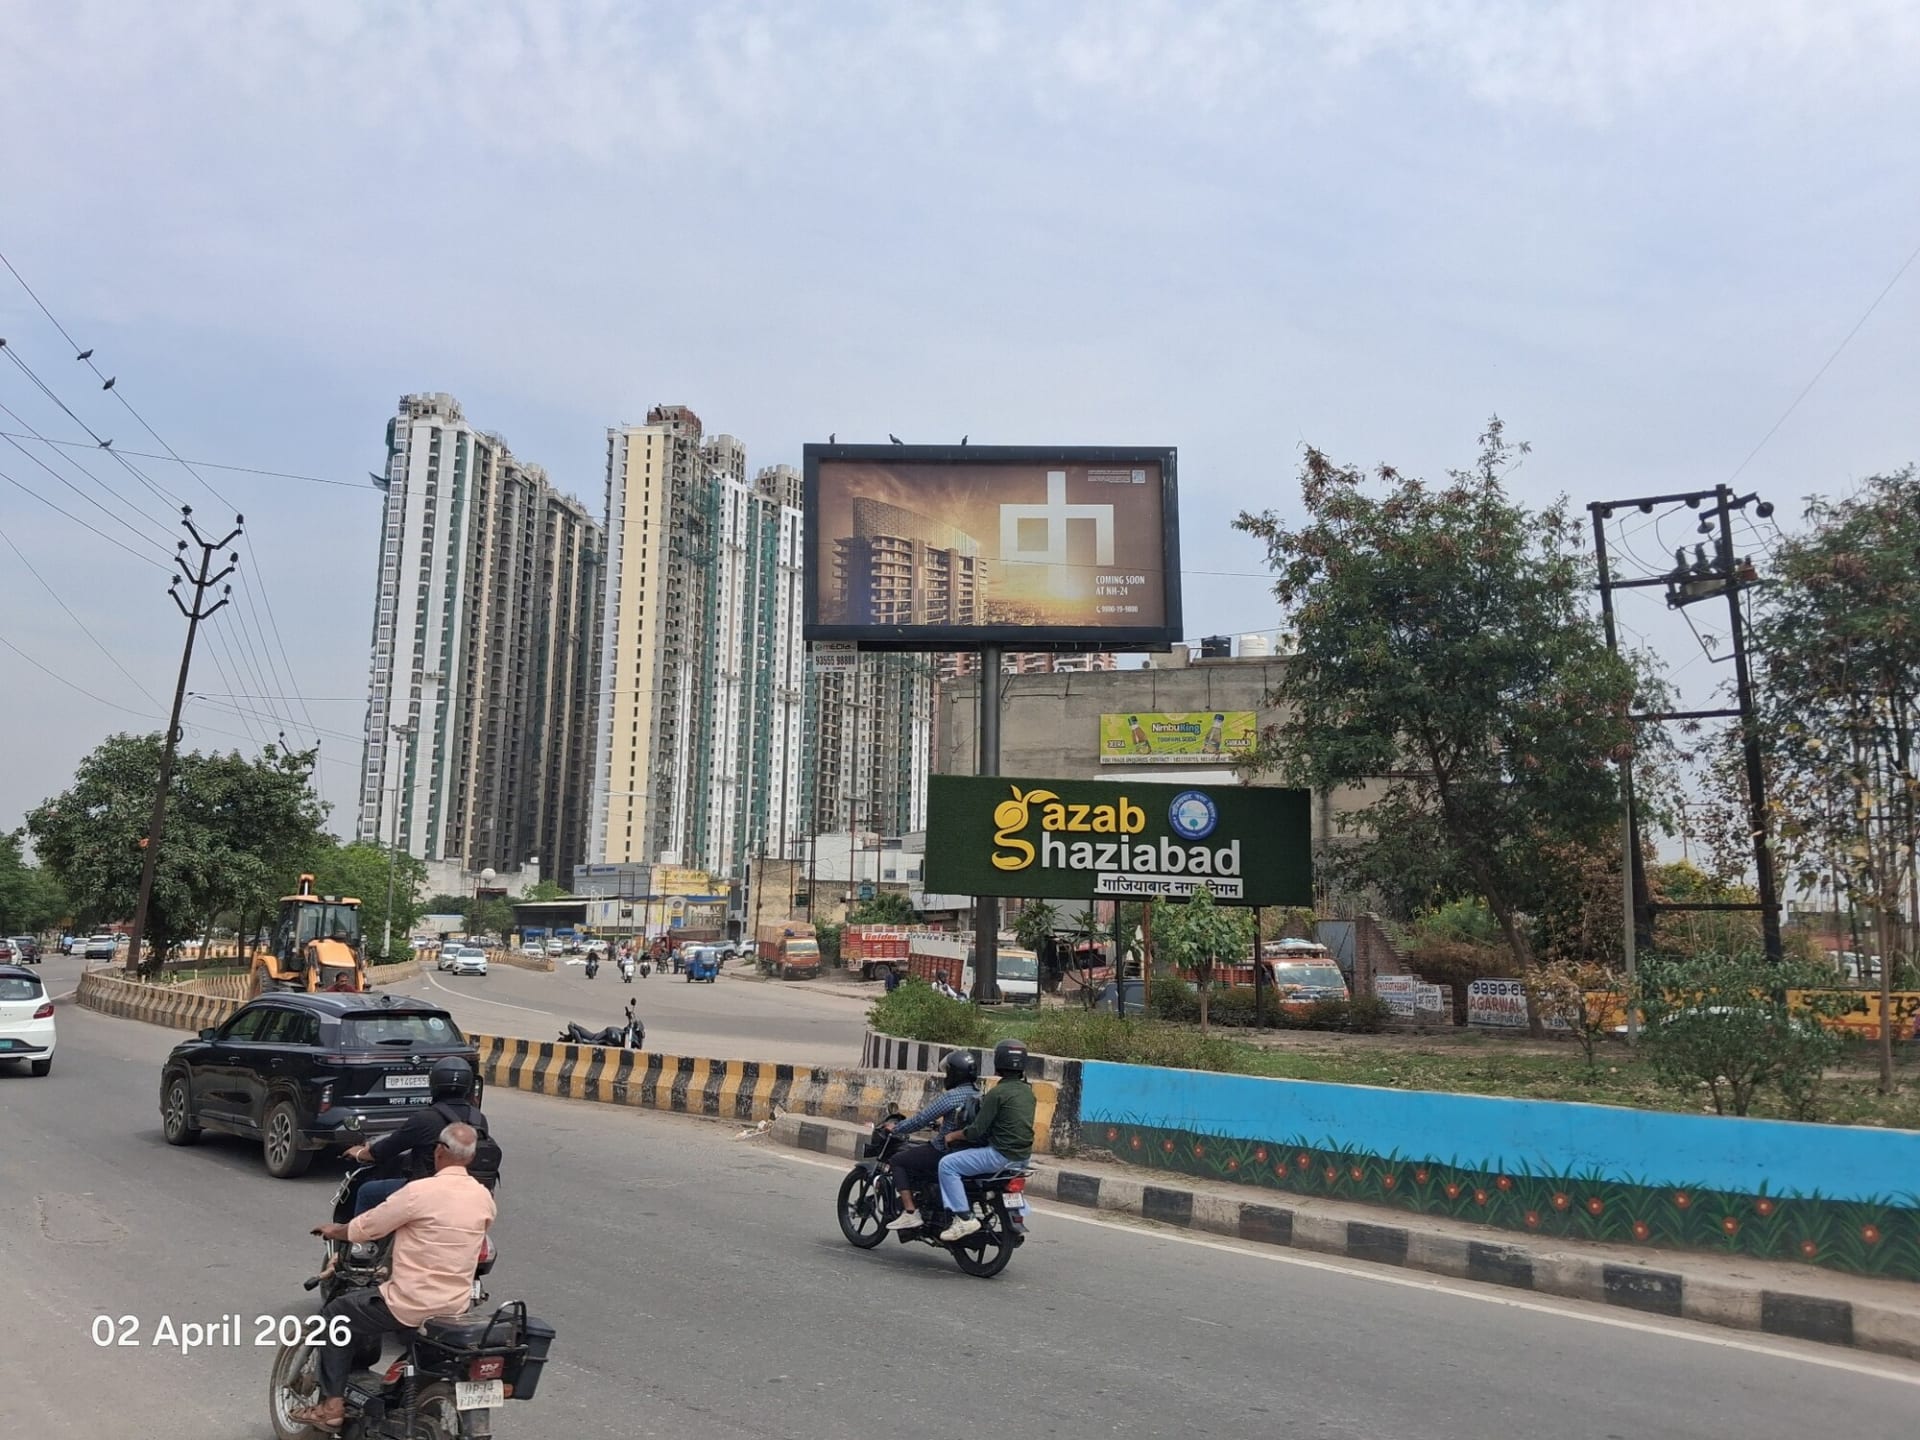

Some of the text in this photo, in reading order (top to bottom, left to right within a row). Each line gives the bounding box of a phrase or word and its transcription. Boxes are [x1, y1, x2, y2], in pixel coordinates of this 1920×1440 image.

[1095, 575, 1145, 585] COMING SOON
[1095, 586, 1104, 596] AT
[1102, 876, 1171, 893] गाजियाबाद
[1469, 996, 1521, 1014] AGARWAL
